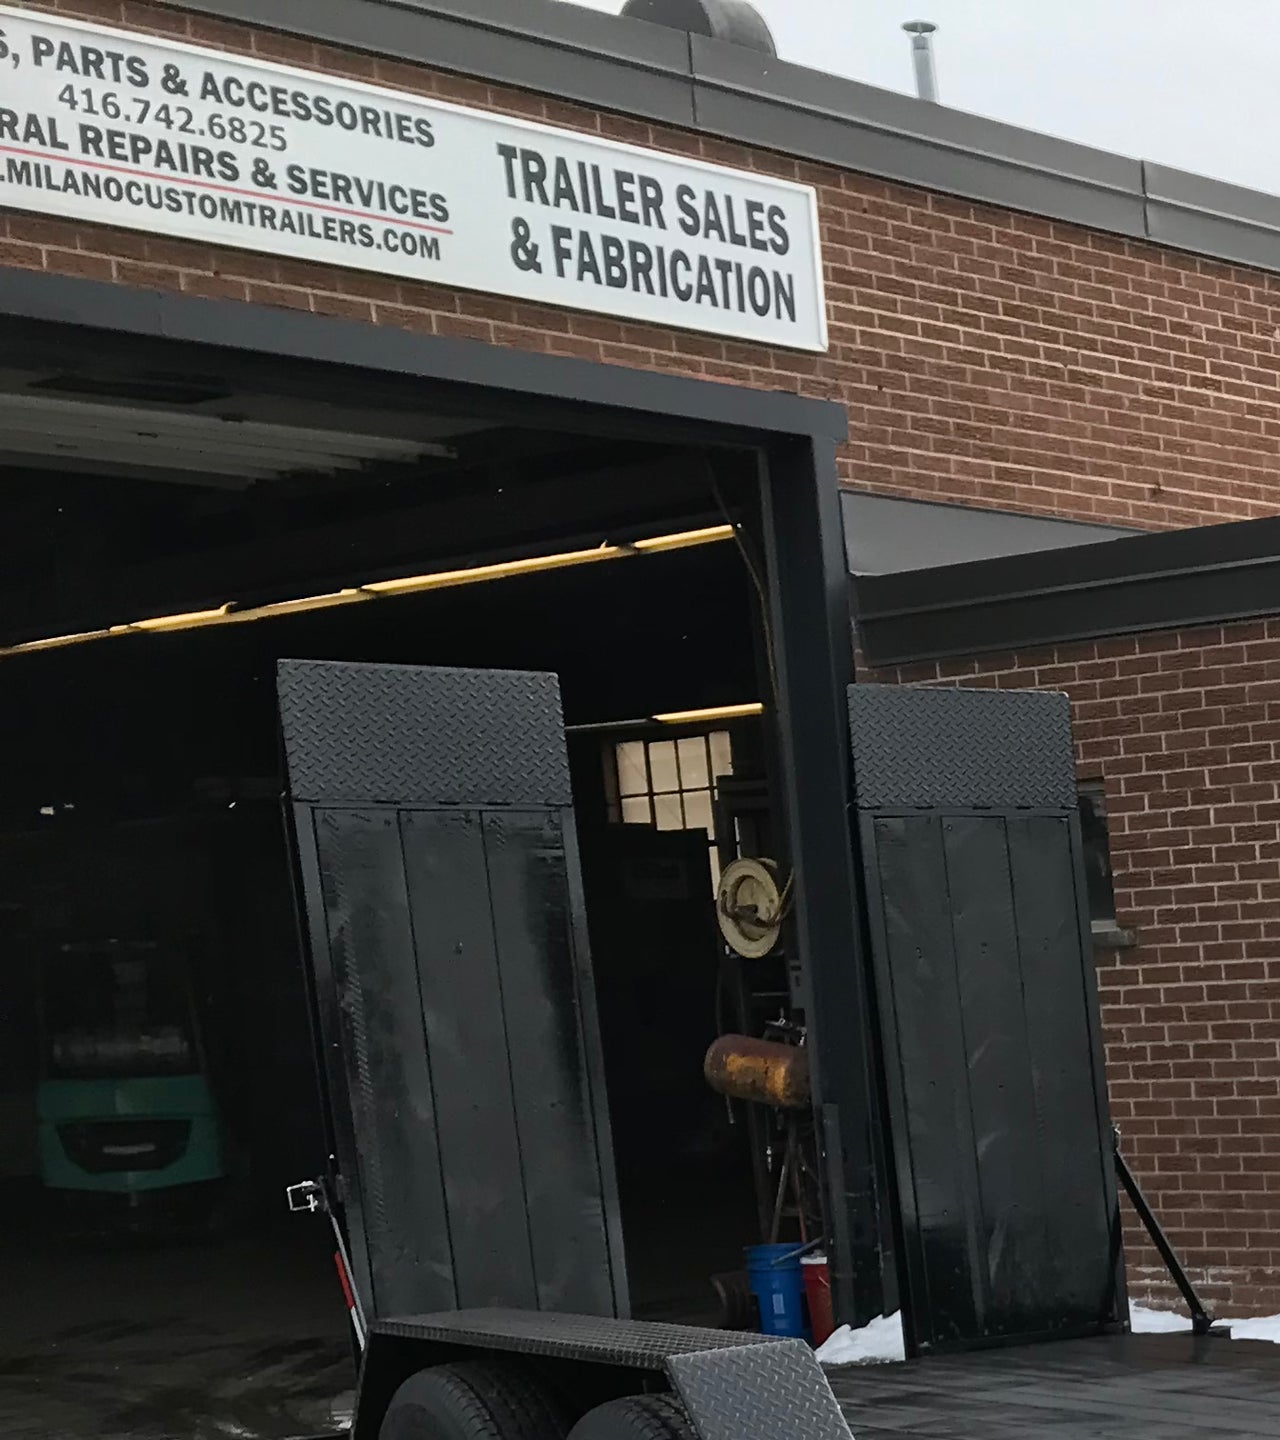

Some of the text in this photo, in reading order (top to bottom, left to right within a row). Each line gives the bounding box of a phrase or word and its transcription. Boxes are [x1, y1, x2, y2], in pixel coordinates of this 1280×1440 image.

[31, 34, 149, 88] PARTS
[161, 63, 189, 97] &
[200, 71, 435, 148] ACCESSORIES
[58, 84, 287, 152] 416.742.6825
[0, 107, 449, 223] RAL REPAIRS & SERVICES
[496, 142, 789, 255] TRAILER SALES
[510, 216, 796, 322] & FABRICATION
